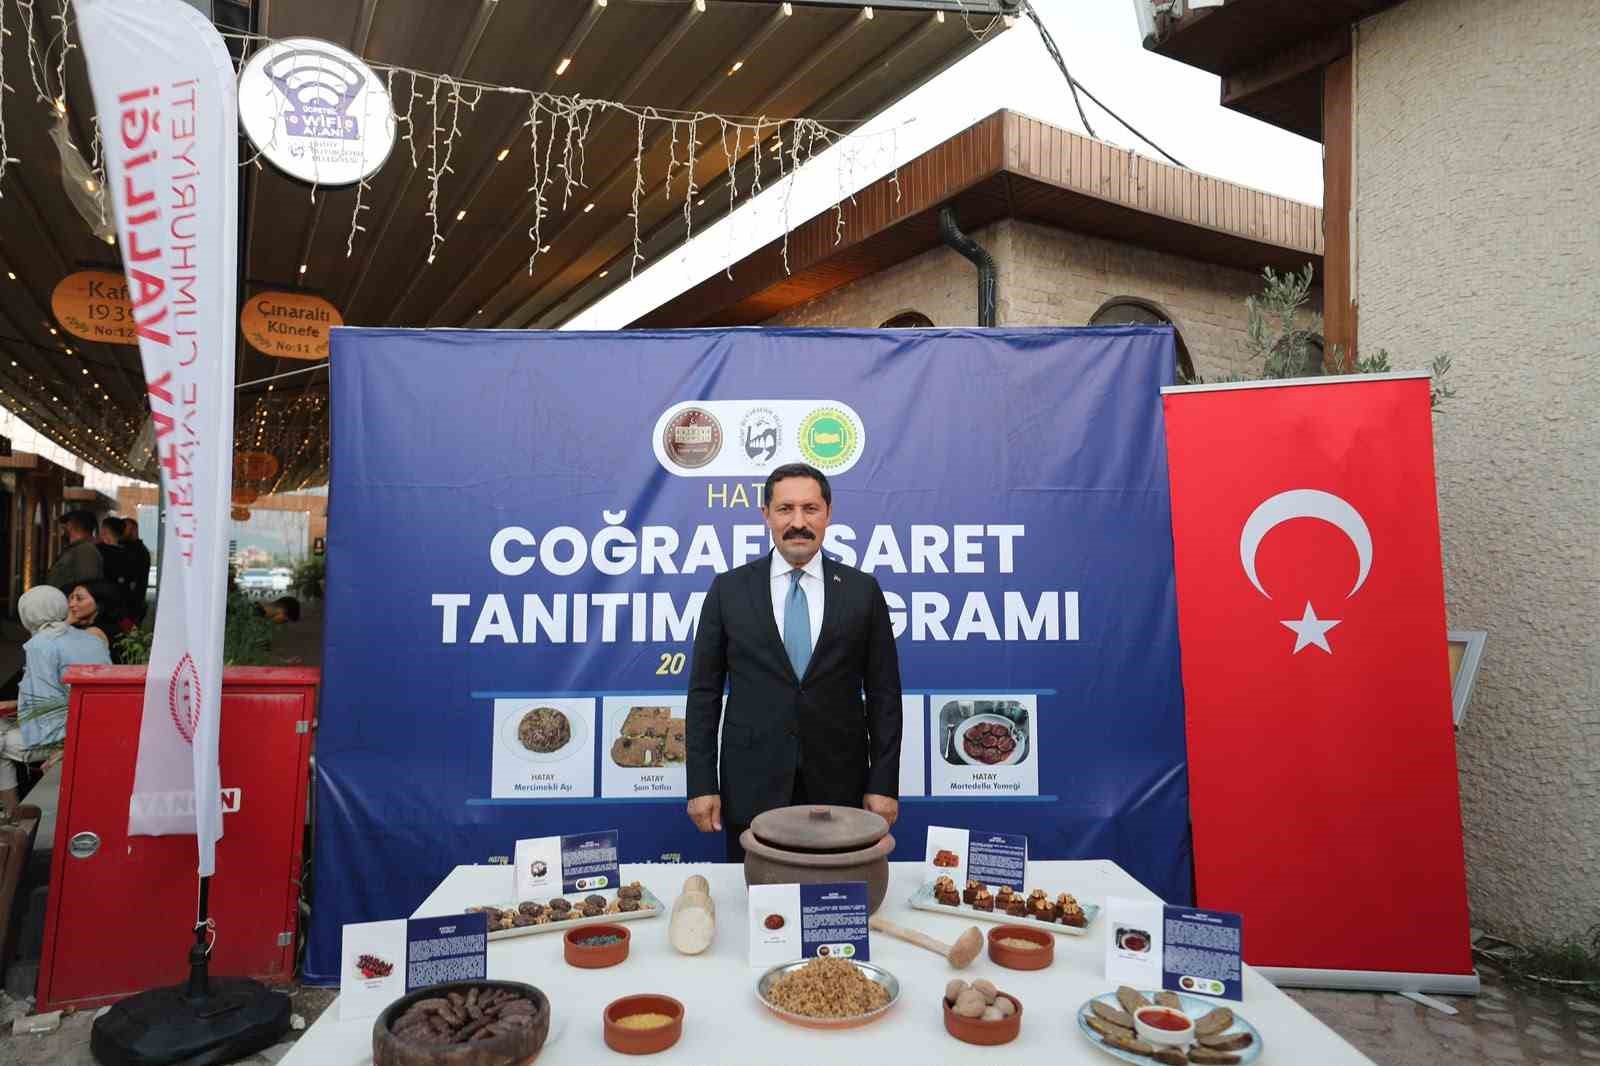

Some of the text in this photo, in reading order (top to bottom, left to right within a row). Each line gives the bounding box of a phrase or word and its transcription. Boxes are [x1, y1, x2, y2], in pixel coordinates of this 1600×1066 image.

[88, 280, 129, 300] Kaf
[256, 300, 331, 322] Çınaraltı
[266, 319, 320, 338] Künefe
[707, 482, 766, 508] HAT
[490, 509, 775, 576] COĞRAF
[431, 592, 708, 644] TANITIM
[640, 775, 664, 783] HATAY
